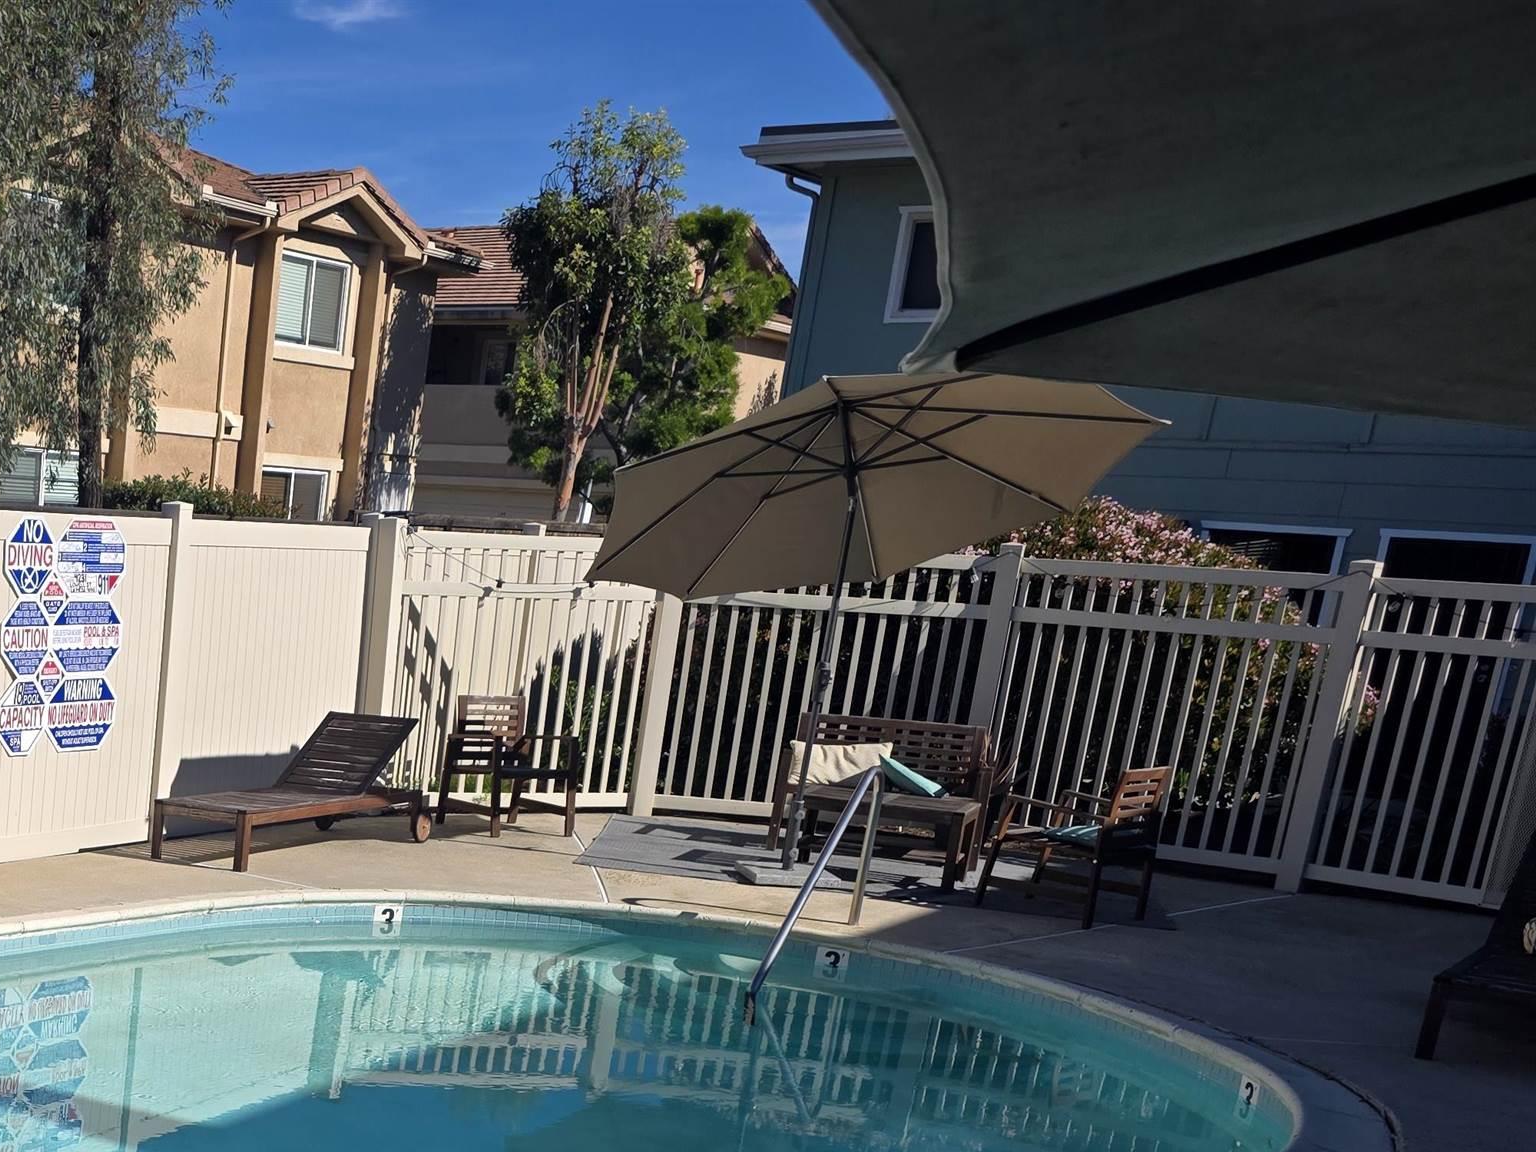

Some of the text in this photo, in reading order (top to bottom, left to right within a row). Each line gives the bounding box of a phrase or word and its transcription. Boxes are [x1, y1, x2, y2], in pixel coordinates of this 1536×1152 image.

[24, 519, 44, 543] NO
[8, 544, 53, 567] DIVING
[97, 574, 109, 595] 911
[3, 628, 48, 650] CAUTION
[84, 626, 101, 638] POOL
[107, 625, 119, 637] SPA
[24, 694, 41, 704] POOL
[64, 678, 103, 701] WARNING
[0, 706, 45, 729] CAPACITY
[48, 701, 115, 726] NO LIFEGUARD ON DUTY
[10, 737, 20, 746] SPA
